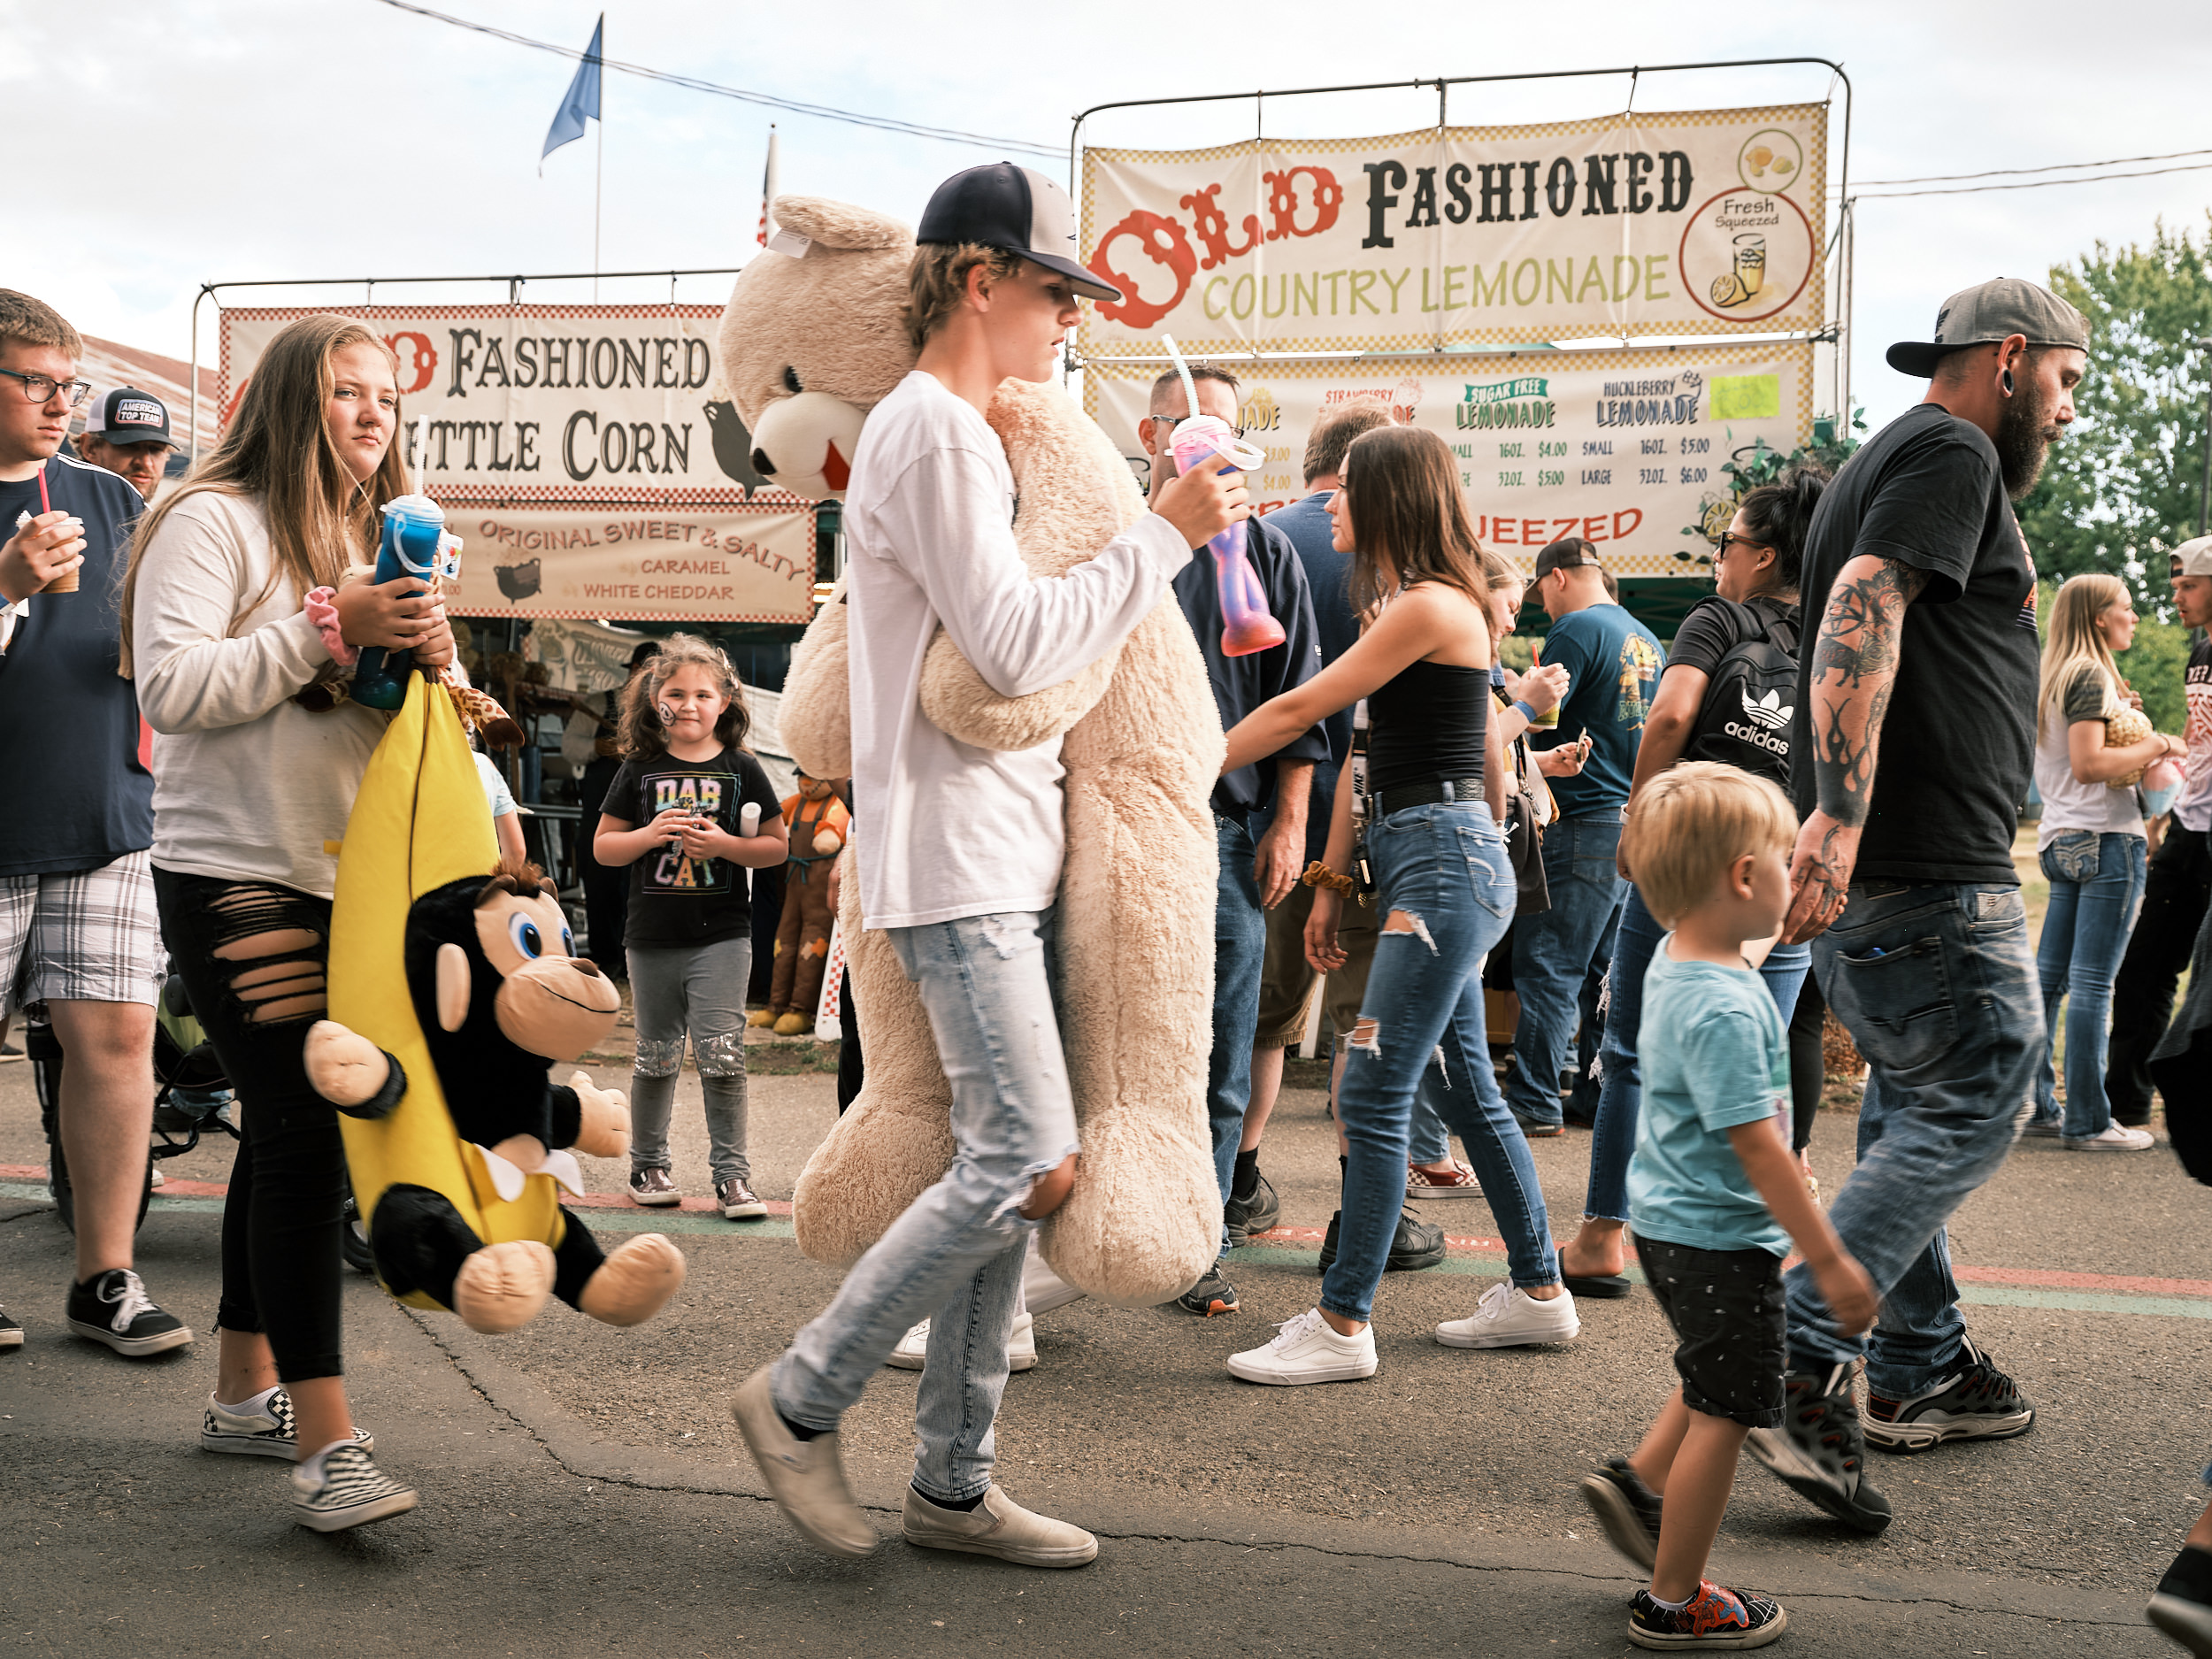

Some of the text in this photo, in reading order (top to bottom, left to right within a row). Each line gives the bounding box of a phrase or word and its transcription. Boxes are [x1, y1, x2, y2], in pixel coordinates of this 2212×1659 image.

[1724, 197, 1774, 214] Fresh
[1716, 214, 1779, 231] Squeezed
[1089, 150, 1694, 329] OLD FASHIONED
[1202, 253, 1671, 320] COUNTRY LEMONADE
[447, 328, 710, 397] FASHIONED
[1471, 379, 1541, 403] SUGAR FREE
[1603, 379, 1676, 397] HUCKLEBERRY
[121, 411, 160, 424] TOP TEAM
[122, 403, 160, 416] AMERICAN
[1456, 400, 1556, 430] LEMONADE
[1596, 397, 1700, 427] LEMONADE
[404, 410, 692, 481] ETTLE CORN
[1538, 441, 1567, 458] $4.00
[1582, 441, 1614, 456] SMALL
[1680, 436, 1709, 455] $5.00
[1581, 468, 1612, 485] LARGE
[1680, 466, 1708, 484] $6.00
[479, 519, 805, 581] ORIGINAL SWEET & SALTY
[641, 559, 730, 575] CARAMEL
[583, 583, 734, 601] WHITE CHEDDAR
[1724, 721, 1790, 755] adidas
[655, 778, 722, 813] DAB
[1353, 771, 1365, 797] NIKE
[655, 853, 715, 887] CAT
